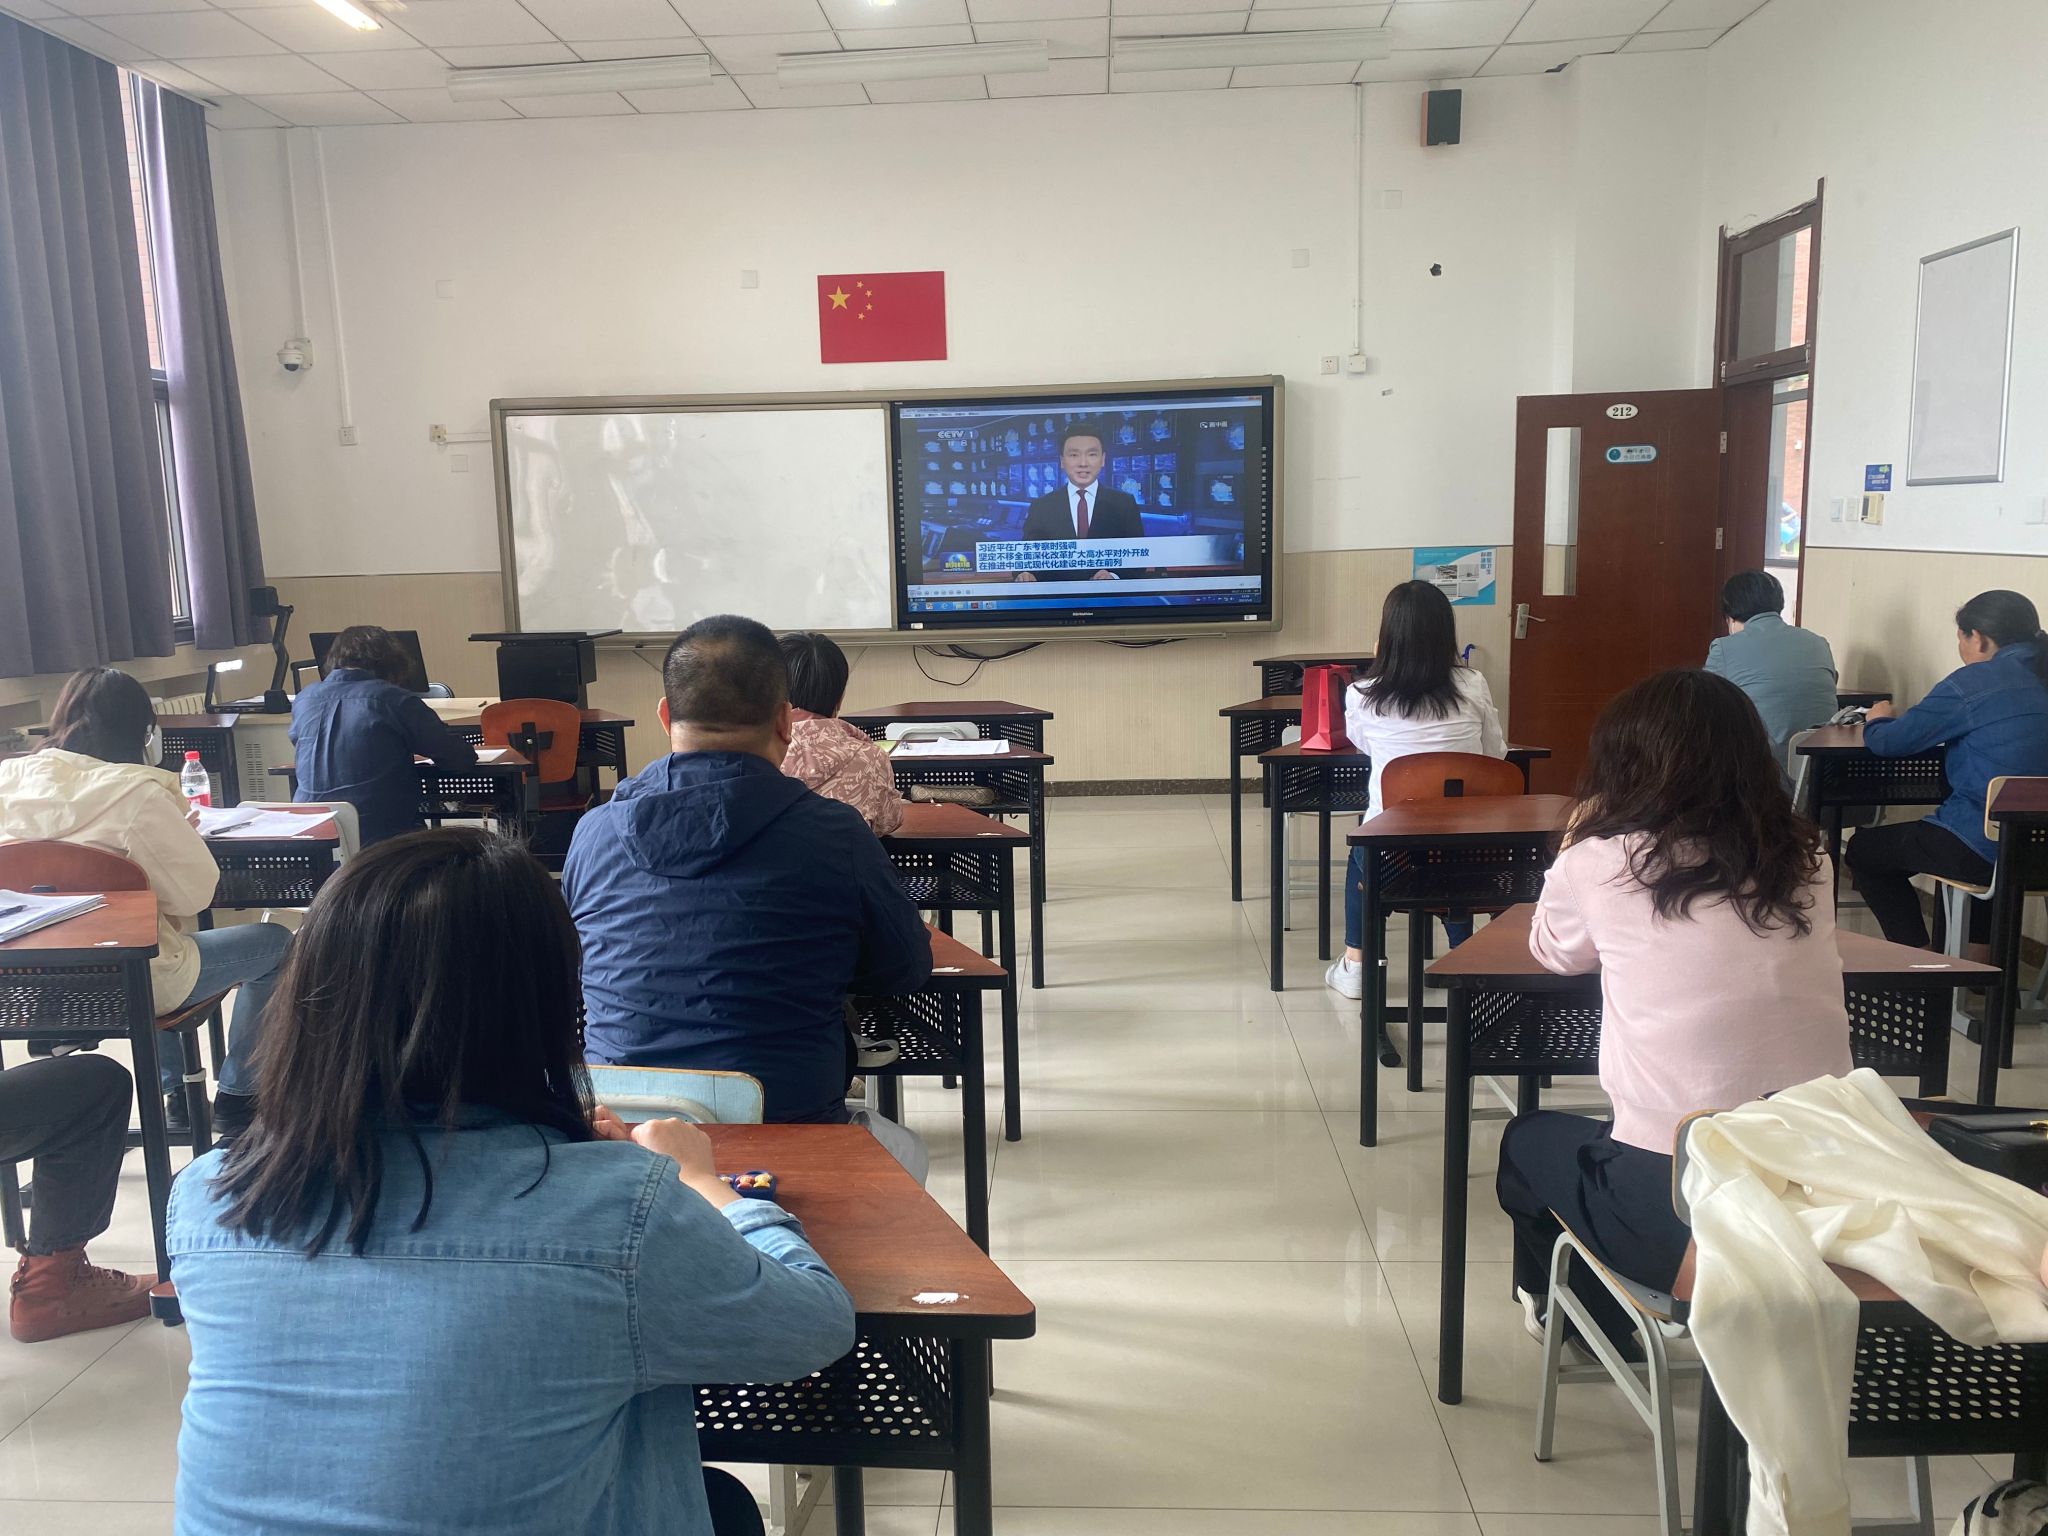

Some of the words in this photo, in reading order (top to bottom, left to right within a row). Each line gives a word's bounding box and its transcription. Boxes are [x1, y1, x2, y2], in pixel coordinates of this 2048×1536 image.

[1612, 406, 1632, 417] 212
[937, 430, 965, 439] CCTV
[978, 541, 1077, 552] 习近平在广东考察时强调
[978, 548, 1150, 561] 坚定不移全面深化改革扩大高水平对外开放
[979, 558, 1123, 570] 在推进中国式现代化建设中走在前列
